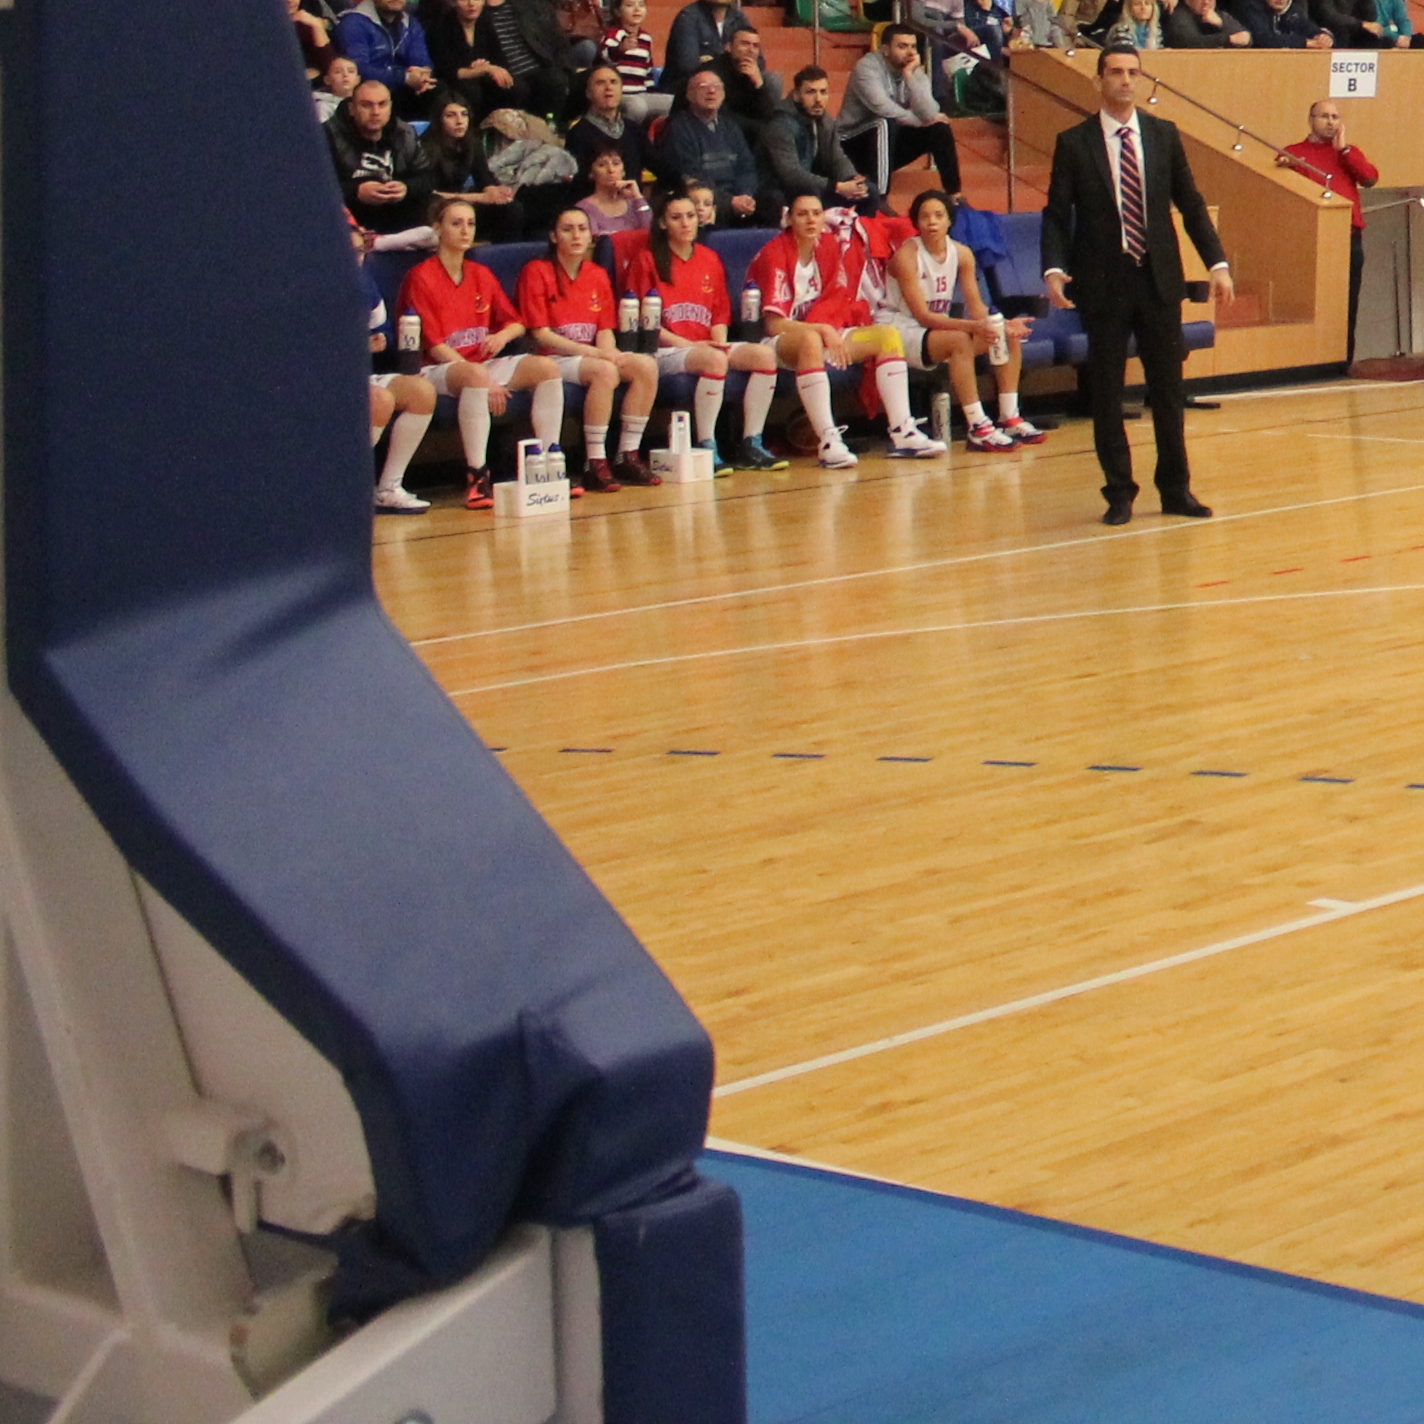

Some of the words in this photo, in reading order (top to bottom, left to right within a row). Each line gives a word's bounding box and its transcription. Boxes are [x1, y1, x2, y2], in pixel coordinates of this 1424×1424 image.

[1331, 62, 1375, 73] SECTOR
[1347, 78, 1357, 92] B
[936, 277, 948, 293] 15
